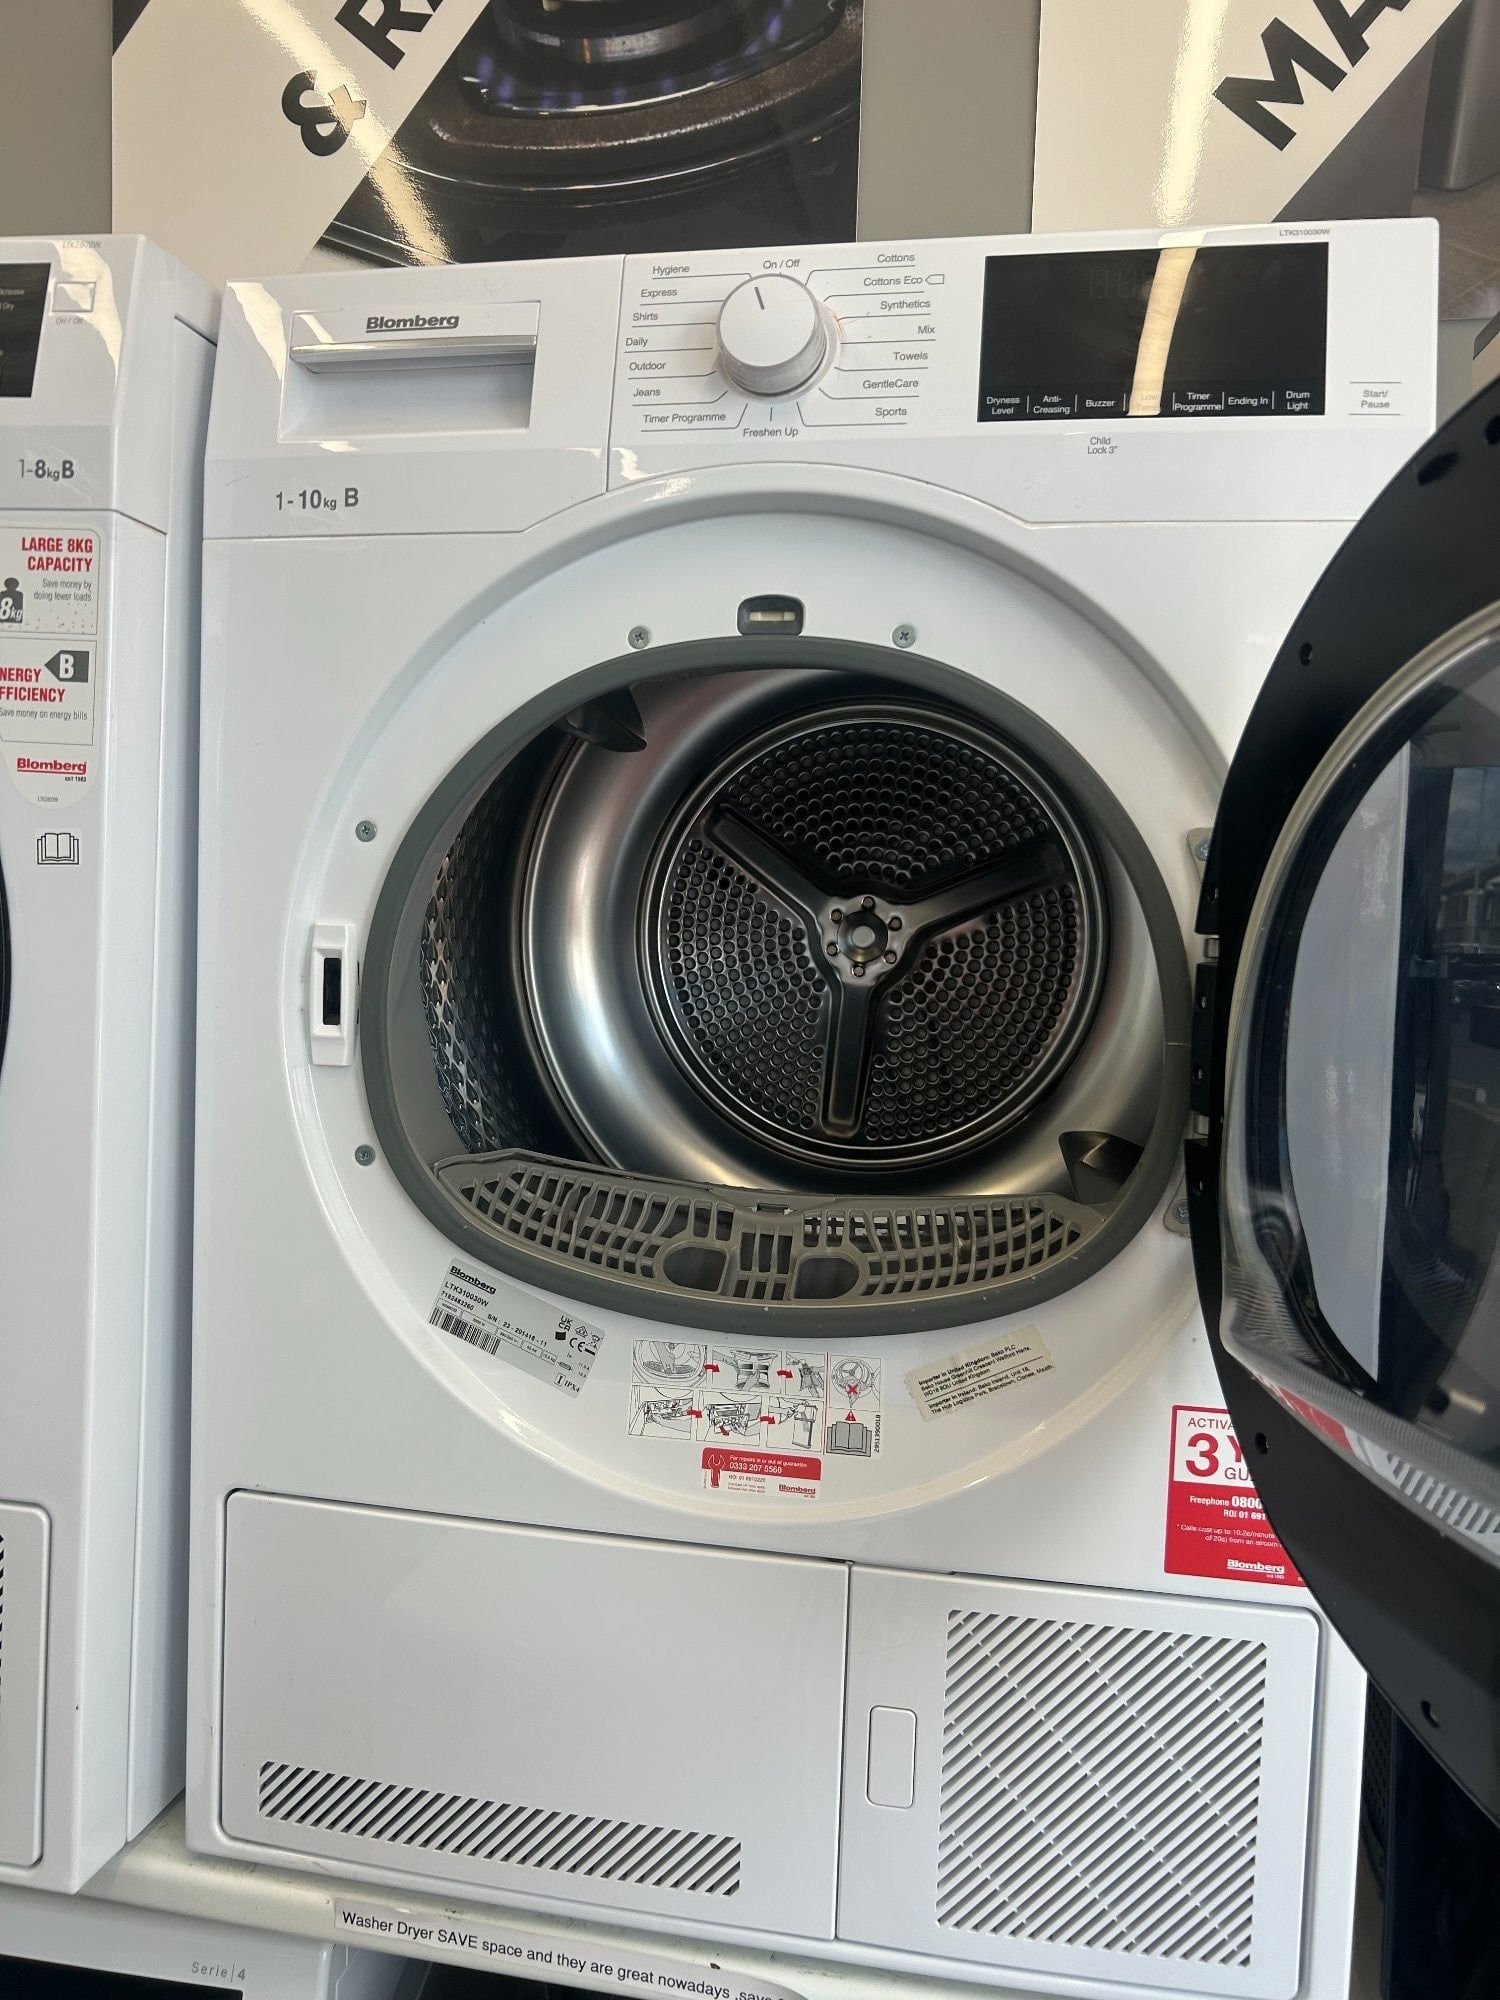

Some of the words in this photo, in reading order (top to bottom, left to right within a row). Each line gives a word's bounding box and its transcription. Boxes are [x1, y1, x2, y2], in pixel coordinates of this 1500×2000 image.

[282, 69, 367, 157] &
[334, 0, 443, 70] R
[877, 253, 915, 263] Cottons
[763, 260, 777, 269] On
[779, 260, 784, 269] /
[785, 259, 800, 268] Off
[652, 265, 690, 275] Hygiene
[863, 277, 900, 287] Cottons
[904, 276, 923, 285] Eco
[641, 289, 678, 299] Express
[880, 300, 931, 311] Synthetics
[632, 312, 658, 321] Shirts
[366, 315, 460, 333] Blomberg
[918, 325, 935, 334] Mix
[625, 337, 648, 347] Daily
[893, 351, 928, 361] Towels
[629, 361, 666, 371] Outdoor
[862, 379, 919, 389] GentleCare
[632, 388, 661, 397] Jeans
[1187, 391, 1210, 400] Timer
[1286, 391, 1310, 399] Drum
[1363, 389, 1388, 399] Start/
[986, 396, 1020, 406] Dryness
[1042, 395, 1062, 403] Anti-
[1085, 400, 1116, 408] Buzzer
[1228, 397, 1258, 406] Ending
[1260, 396, 1268, 405] In
[1360, 400, 1390, 409] Pause
[875, 407, 907, 418] Sports
[992, 407, 1014, 415] Level
[1033, 405, 1070, 415] Creasing
[1174, 403, 1221, 412] Programme
[1287, 402, 1309, 412] Light
[643, 414, 670, 423] Timer
[671, 413, 726, 425] Programme
[743, 428, 782, 437] Freshen
[784, 427, 799, 438] Up
[1090, 437, 1111, 445] Child
[1087, 446, 1107, 454] Lock
[62, 460, 75, 479] B
[344, 487, 359, 507] B
[21, 537, 63, 553] LARGE
[67, 538, 93, 553] 8KG
[27, 555, 93, 572] CAPACITY
[42, 578, 58, 588] Save
[60, 580, 83, 590] money
[84, 580, 92, 591] by
[34, 591, 53, 602] doing
[54, 592, 72, 600] fewer
[73, 592, 92, 601] loads
[59, 654, 74, 679] B
[0, 667, 41, 682] NERGY
[0, 687, 65, 703] FFICIENCY
[16, 709, 38, 719] money
[49, 711, 71, 721] energy
[73, 710, 88, 720] bills
[17, 758, 87, 775] Blomberg
[449, 1265, 497, 1295] Blomberg
[444, 1281, 490, 1307] LTK310030W
[1185, 1432, 1219, 1477] 3
[1225, 1467, 1253, 1481] GU
[1189, 1495, 1229, 1506] Freephone
[1223, 1509, 1237, 1518] ROI
[1239, 1510, 1248, 1519] 01
[1251, 1511, 1266, 1520] 691
[1227, 1558, 1285, 1574] Blomberg
[342, 1910, 394, 1934] Washer
[397, 1921, 434, 1941] Dryer
[437, 1929, 478, 1950] SAVE
[482, 1939, 522, 1958] space
[526, 1947, 552, 1964] and
[556, 1954, 586, 1973] they
[590, 1962, 613, 1976] are
[617, 1966, 654, 1985] great
[658, 1974, 730, 2000] nowadays
[191, 1962, 228, 1979] Serie
